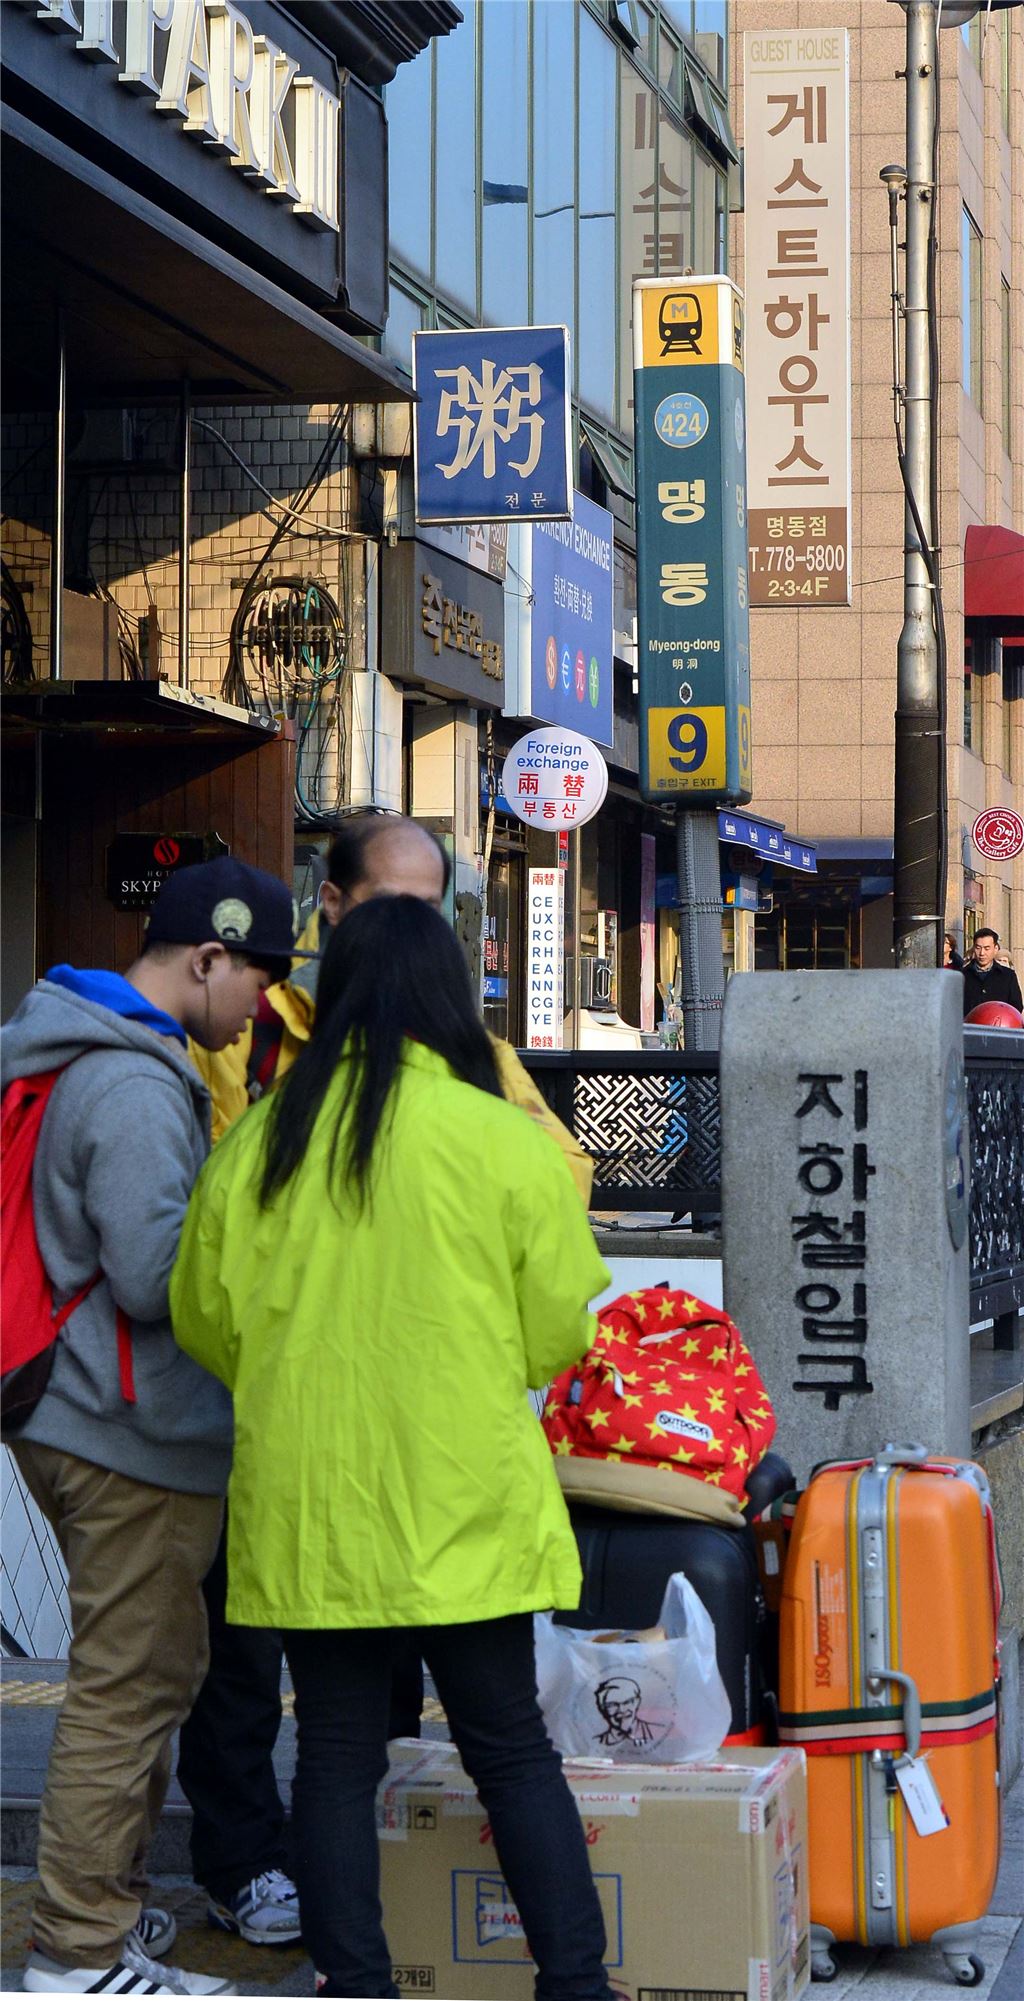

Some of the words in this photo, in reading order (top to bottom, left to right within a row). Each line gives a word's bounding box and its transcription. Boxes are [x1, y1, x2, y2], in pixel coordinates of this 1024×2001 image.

[750, 39, 792, 63] GUEST
[797, 37, 839, 61] HOUSE
[763, 86, 830, 487] 게스트하우스
[433, 358, 546, 480] 粥
[661, 412, 702, 437] 424
[766, 515, 828, 538] 명동점
[574, 523, 610, 571] EXCHANGE
[658, 479, 709, 607] 명동
[649, 638, 721, 654] Myeong-dong
[527, 741, 582, 756] Foreign
[667, 713, 708, 773] 9
[517, 756, 589, 771] exchange
[693, 777, 717, 787] EXIT
[522, 800, 577, 820] 부동산
[984, 846, 1006, 857] Gallery
[121, 880, 162, 893] SKYP
[791, 1069, 877, 1411] 지하철입구
